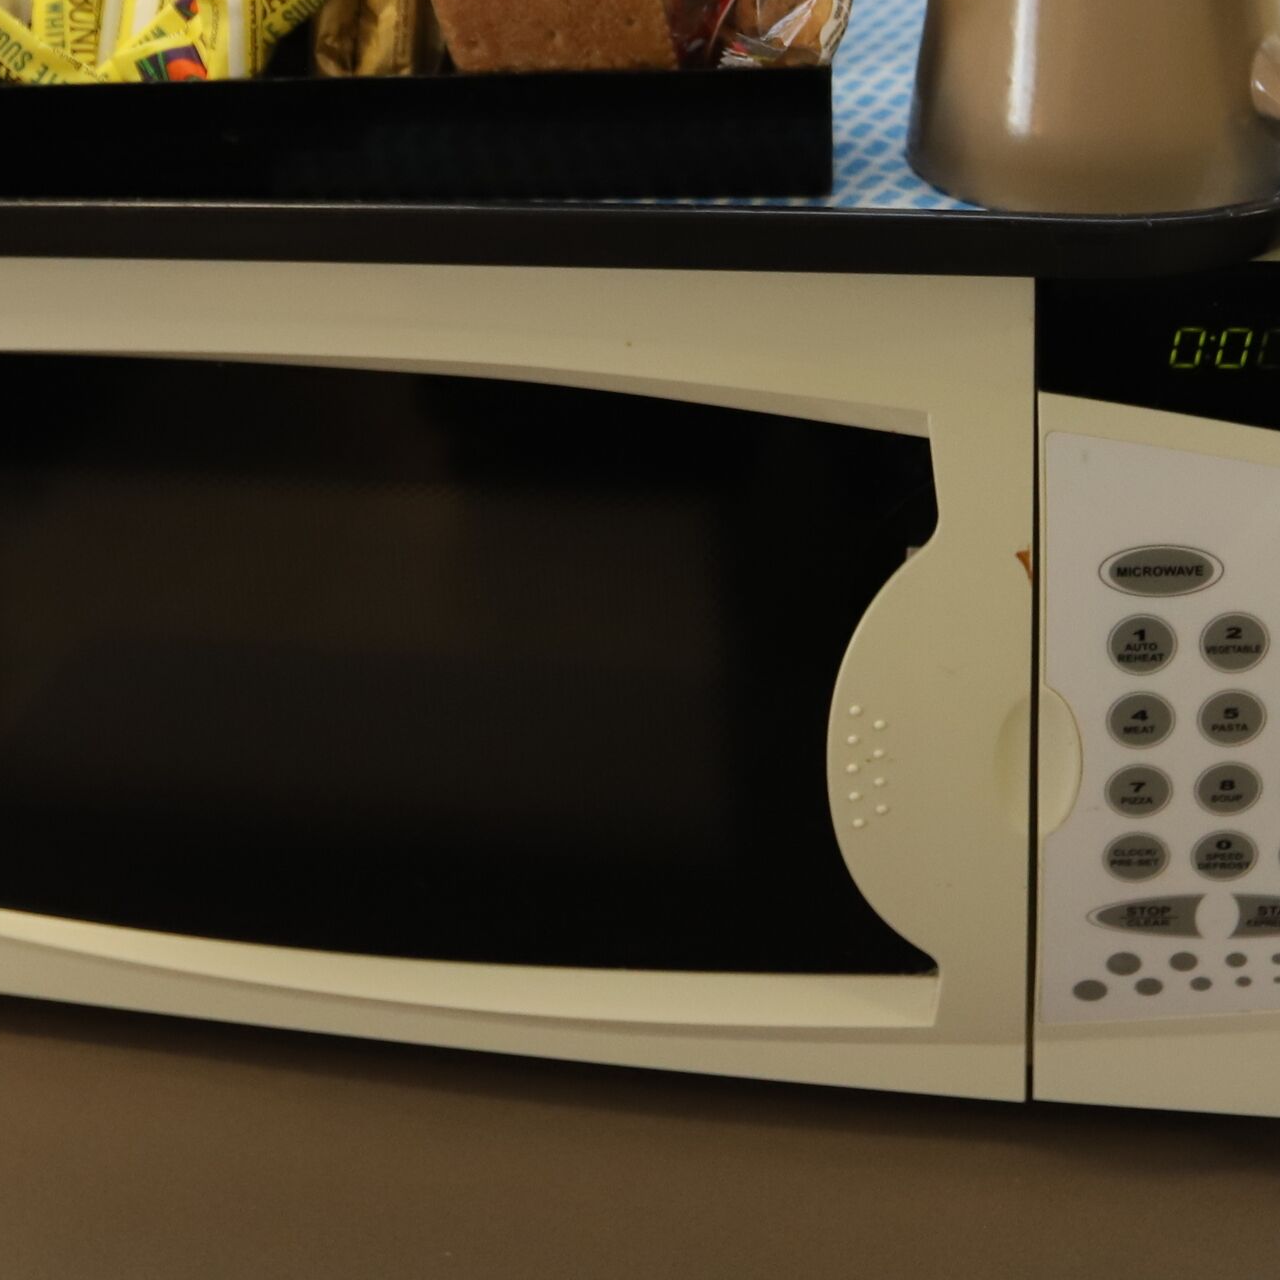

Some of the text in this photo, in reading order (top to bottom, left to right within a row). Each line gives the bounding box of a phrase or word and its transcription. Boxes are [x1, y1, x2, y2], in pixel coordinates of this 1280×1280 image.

[1116, 564, 1204, 578] MICROWAVE
[1132, 629, 1145, 642] 1
[1225, 627, 1242, 640] 2
[1124, 643, 1158, 652] AUTO
[1205, 645, 1261, 654] VEGETABLE
[1117, 653, 1164, 663] REHEAT
[1131, 709, 1148, 721] 4
[1223, 708, 1240, 720] 5
[1123, 726, 1155, 735] MEAT
[1211, 723, 1248, 733] PASTA
[1129, 782, 1146, 793] 7
[1219, 780, 1236, 791] 8
[1121, 796, 1153, 805] PIZZA
[1210, 794, 1243, 803] SOUP
[1126, 906, 1172, 917] STOP
